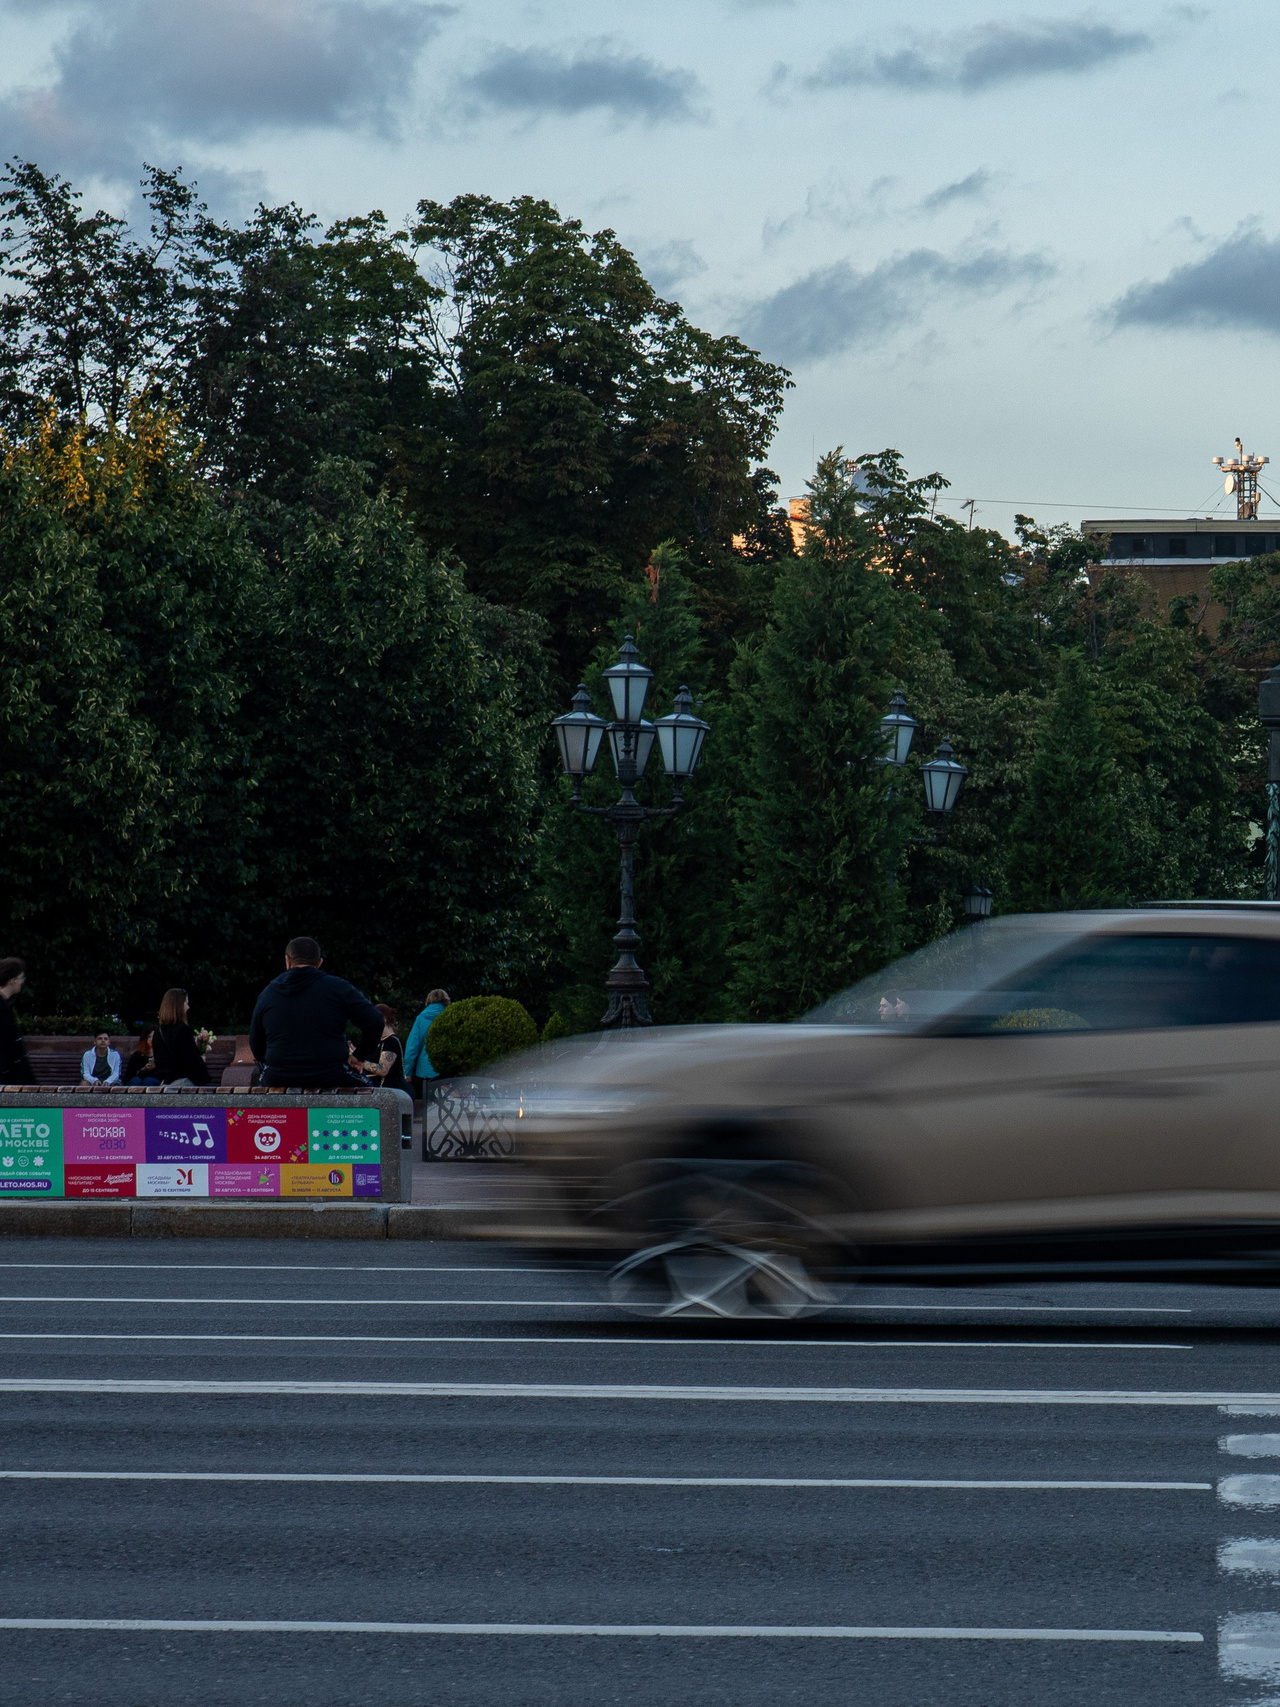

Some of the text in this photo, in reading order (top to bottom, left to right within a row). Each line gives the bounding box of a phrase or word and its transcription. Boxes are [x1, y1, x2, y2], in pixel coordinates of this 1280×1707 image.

[82, 1126, 126, 1138] МОСКВА
[5, 1140, 50, 1148] МОСКВЕ
[100, 1139, 126, 1150] 2030
